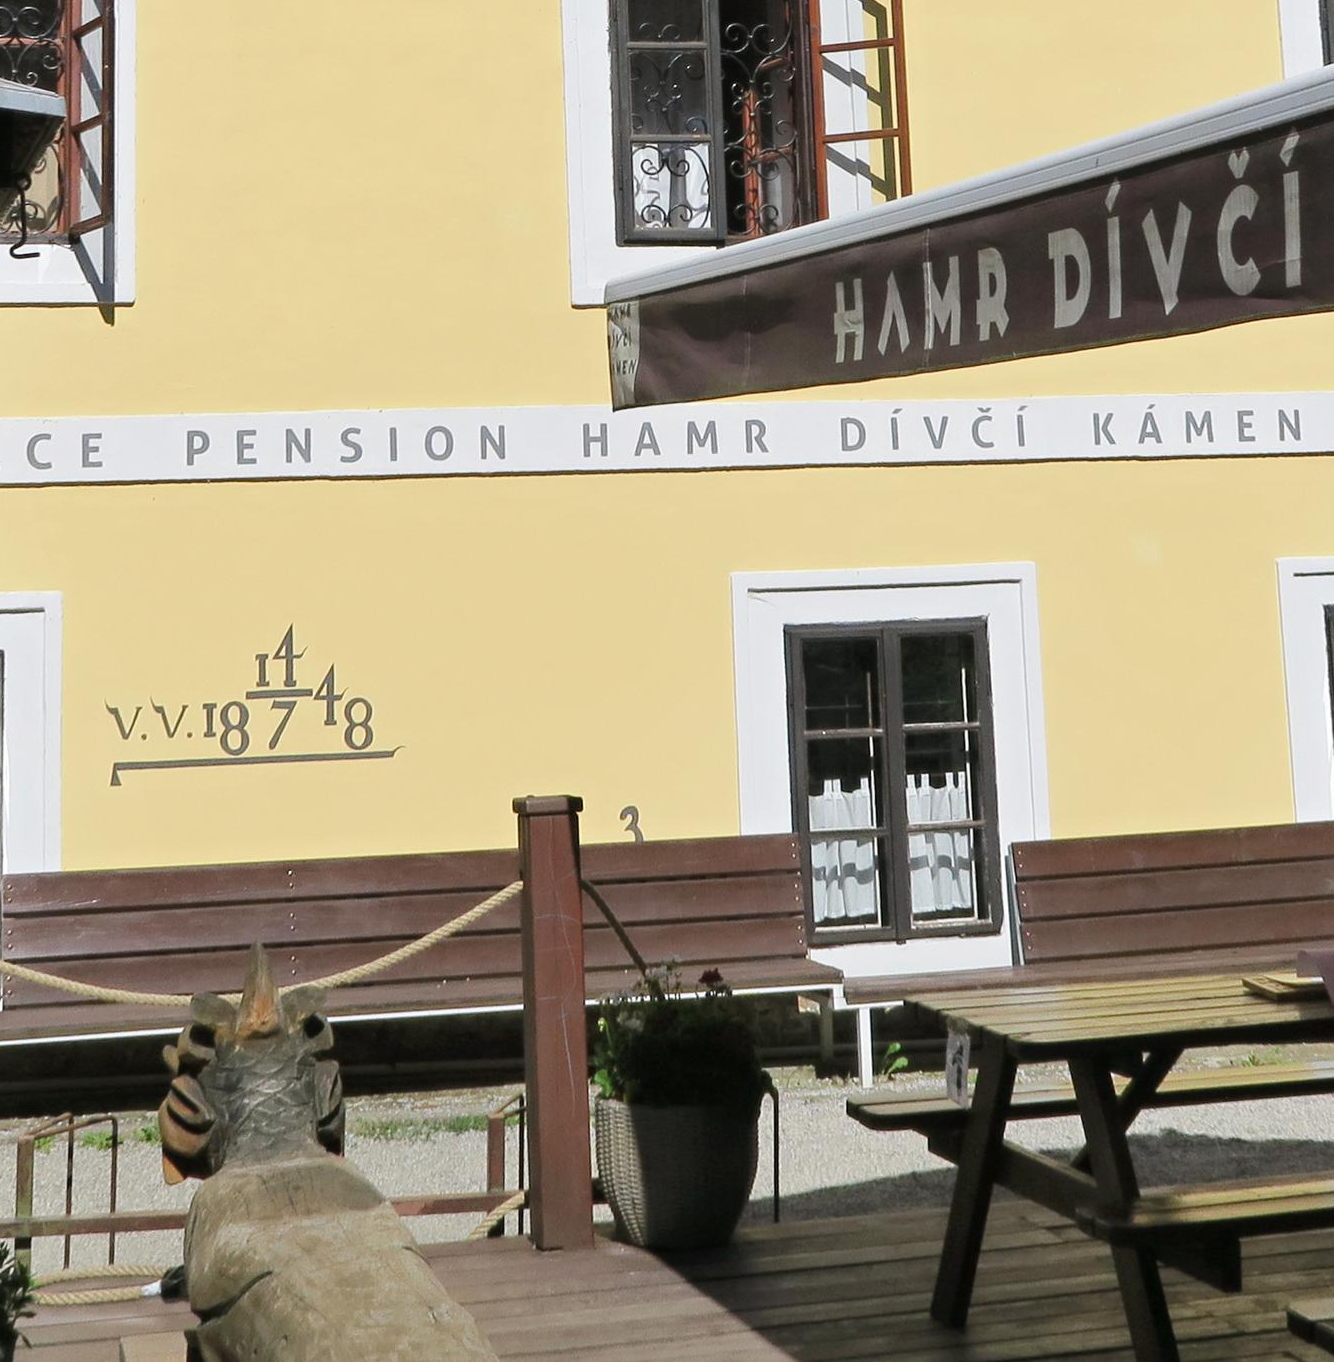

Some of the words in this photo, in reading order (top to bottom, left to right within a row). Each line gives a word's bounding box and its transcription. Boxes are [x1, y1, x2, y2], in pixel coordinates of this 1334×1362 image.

[833, 246, 1010, 364] HAMR
[1047, 127, 1303, 330] DÍVČÍ
[185, 425, 508, 467] PENSION
[581, 418, 770, 458] HAMR
[839, 406, 1029, 453] DÍVČÍ
[1091, 404, 1303, 446] KÁMEN
